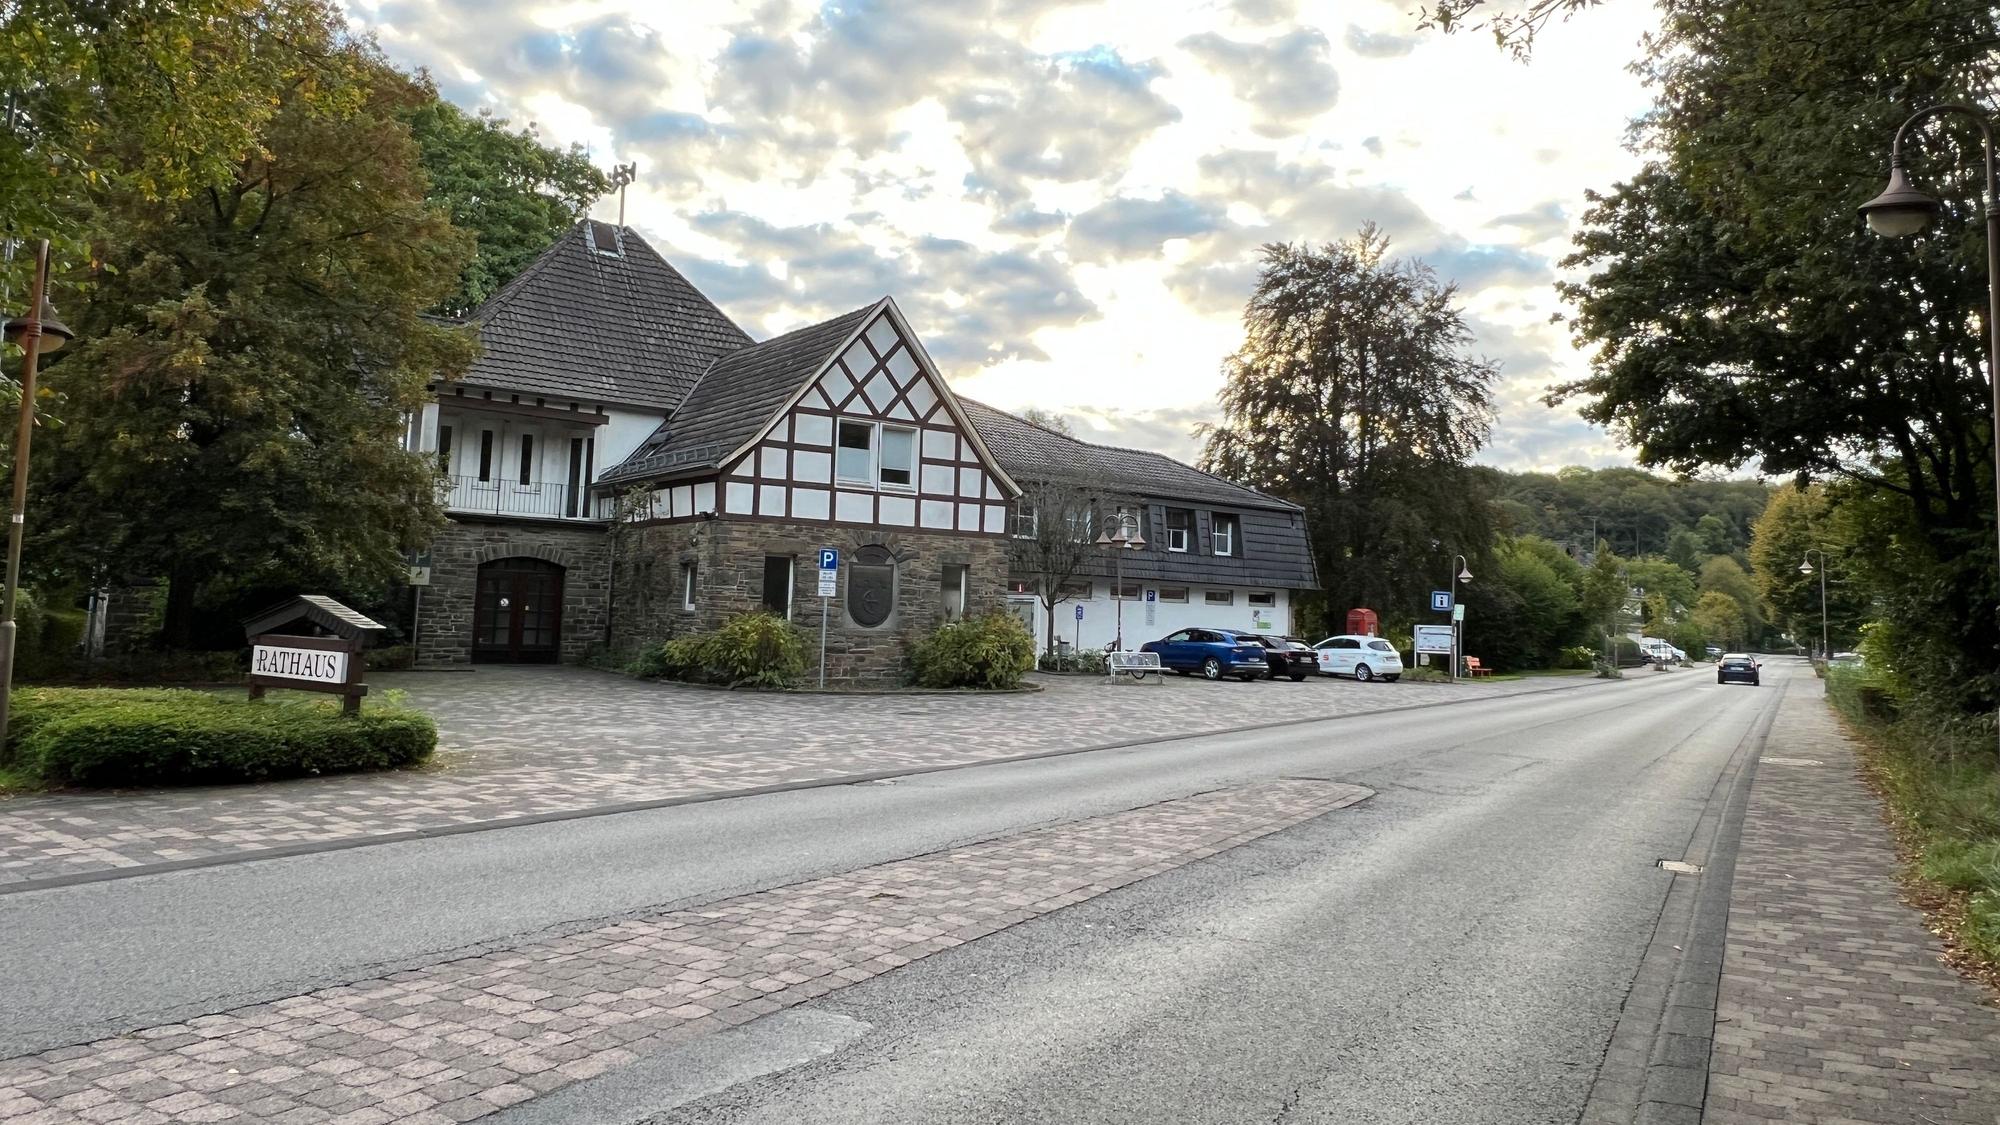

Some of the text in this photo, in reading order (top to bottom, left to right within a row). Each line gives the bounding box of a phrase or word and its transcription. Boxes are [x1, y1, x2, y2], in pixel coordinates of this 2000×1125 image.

[823, 552, 834, 567] P
[1147, 591, 1154, 601] P
[1439, 596, 1444, 606] i
[257, 649, 337, 679] RATHAUS
